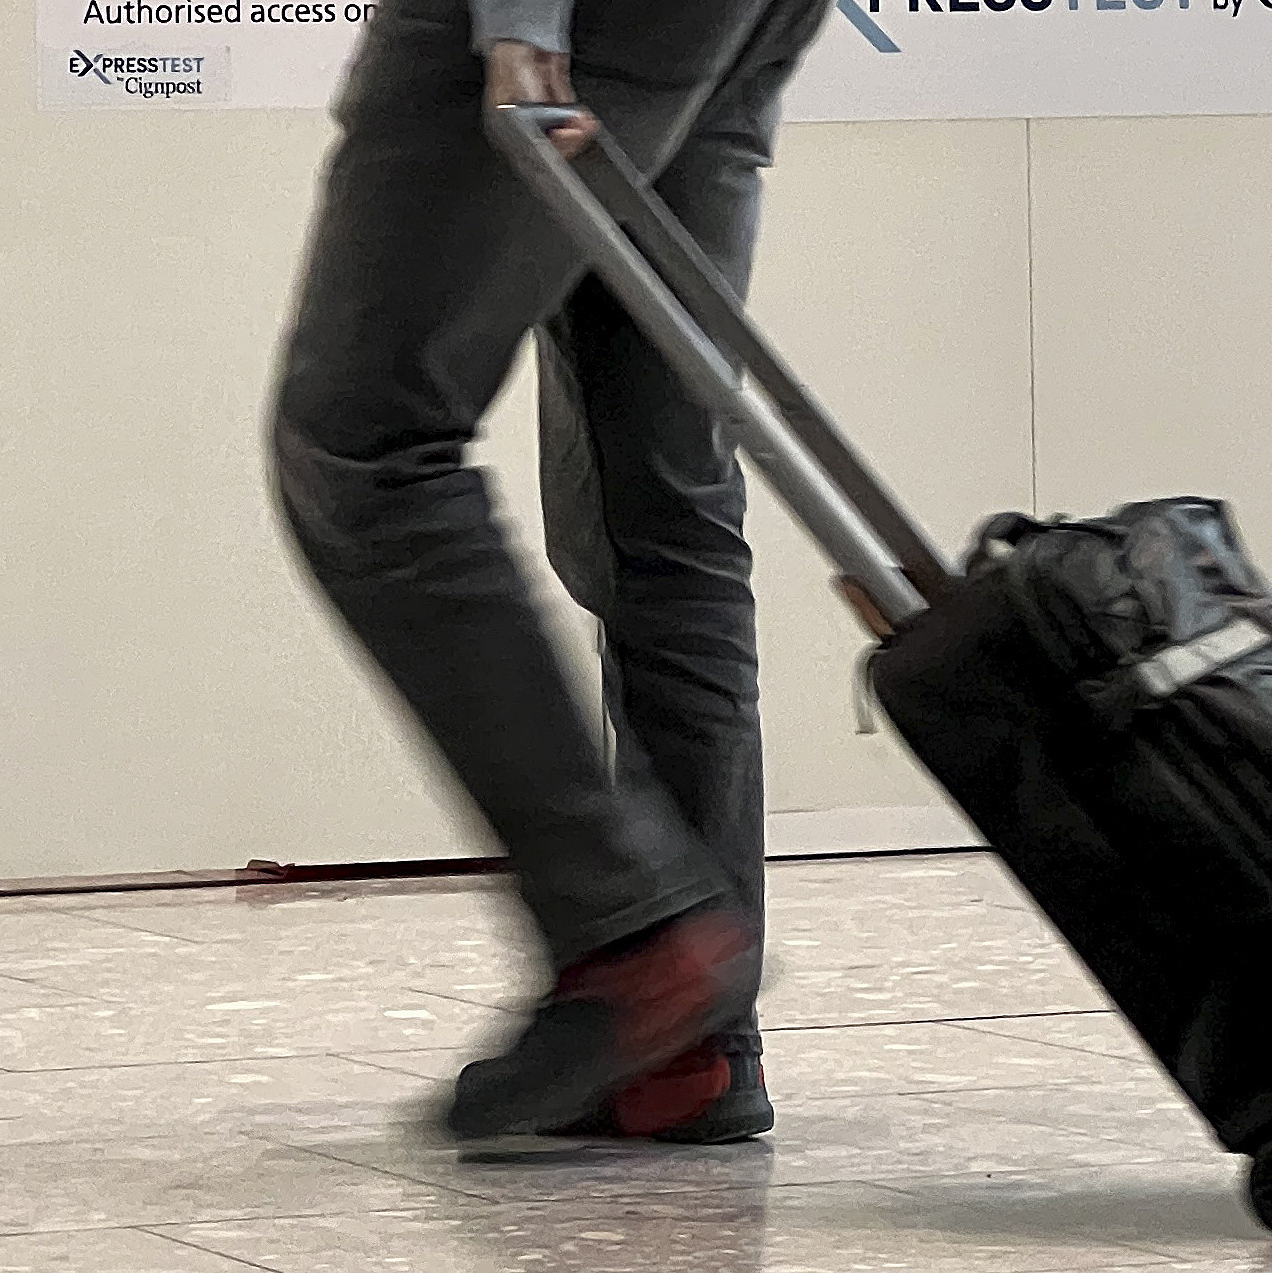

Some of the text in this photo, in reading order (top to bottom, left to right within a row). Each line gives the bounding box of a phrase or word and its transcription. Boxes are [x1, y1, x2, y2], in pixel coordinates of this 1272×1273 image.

[250, 3, 336, 23] access
[69, 49, 205, 85] EXPRESSTEST
[124, 76, 203, 99] Cignpost
